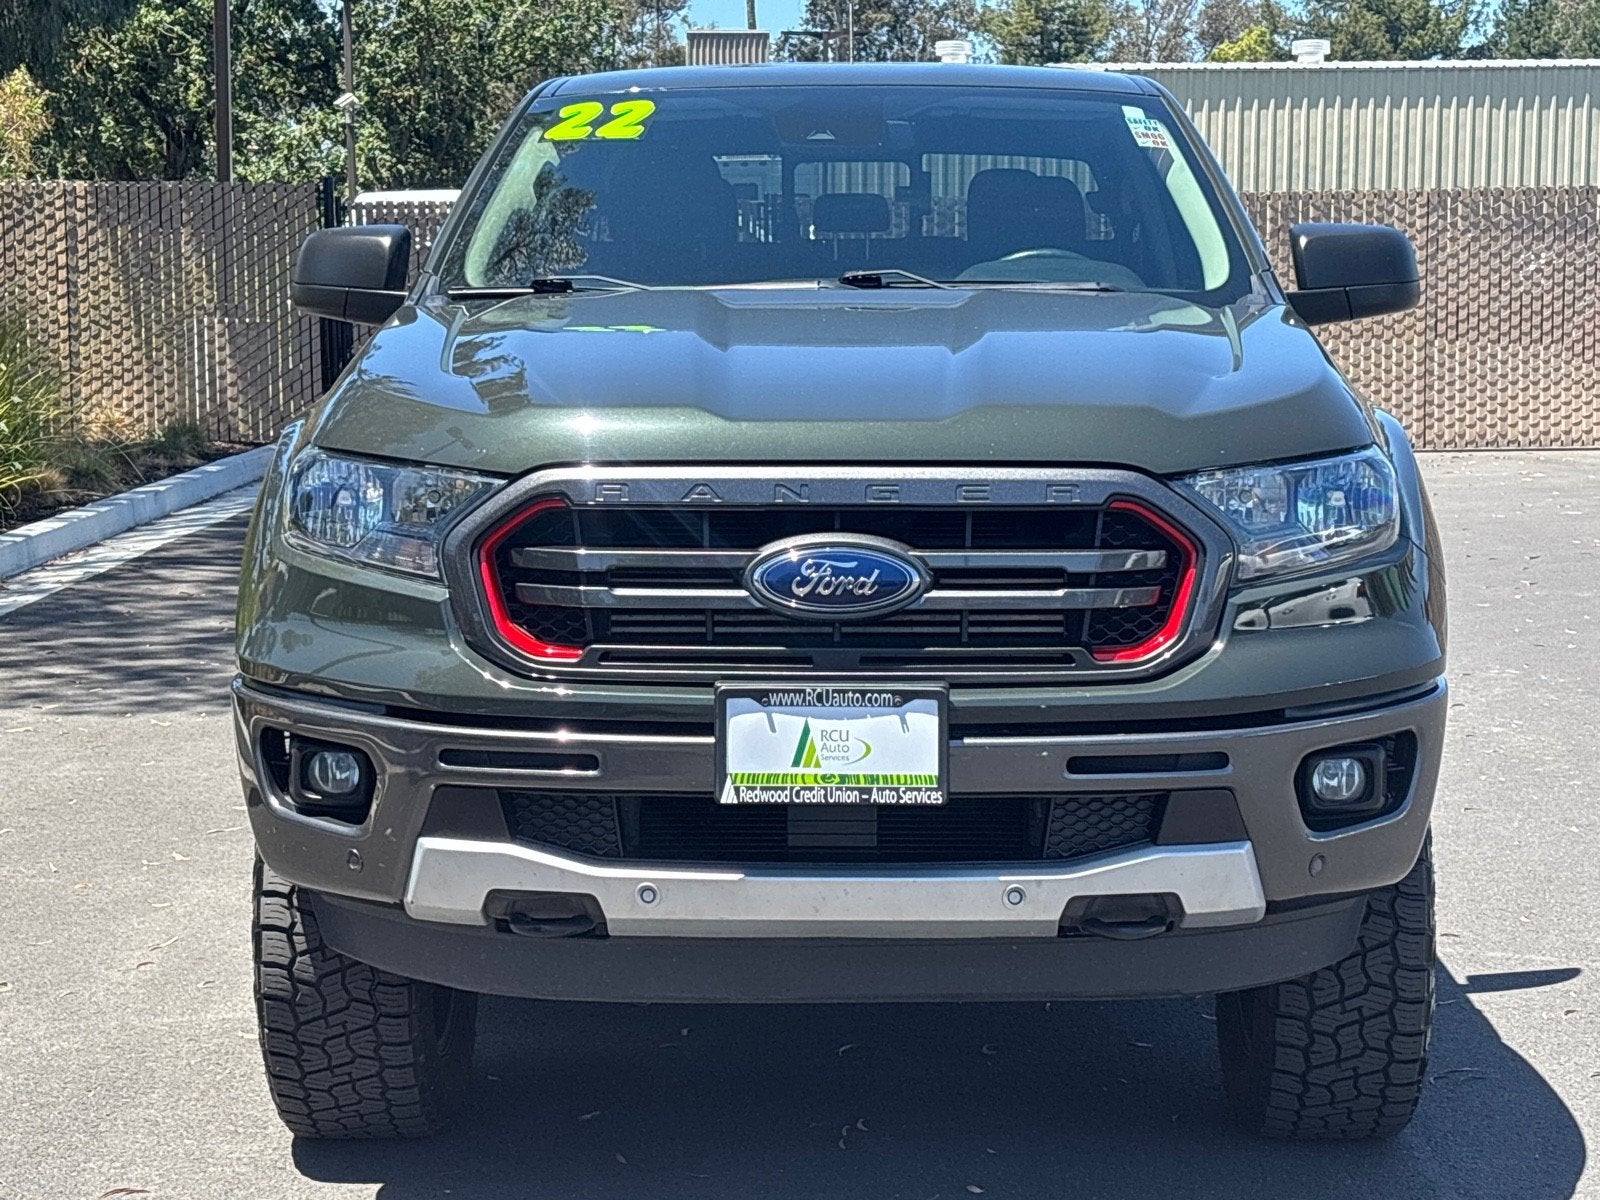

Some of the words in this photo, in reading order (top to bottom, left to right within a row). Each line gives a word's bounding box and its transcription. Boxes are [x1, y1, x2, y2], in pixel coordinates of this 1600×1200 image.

[544, 100, 656, 140] 22
[1134, 131, 1166, 140] SMOG
[1151, 139, 1169, 147] OK
[594, 483, 1081, 503] RANGER
[791, 558, 881, 596] Ford
[768, 688, 894, 707] www.RCUauto.com
[820, 729, 850, 742] RCU
[820, 742, 850, 753] Auto
[739, 786, 789, 804] Redwood
[792, 786, 826, 804] Credit
[827, 786, 860, 804] Union
[870, 787, 898, 804] Auto
[899, 787, 943, 804] Services
